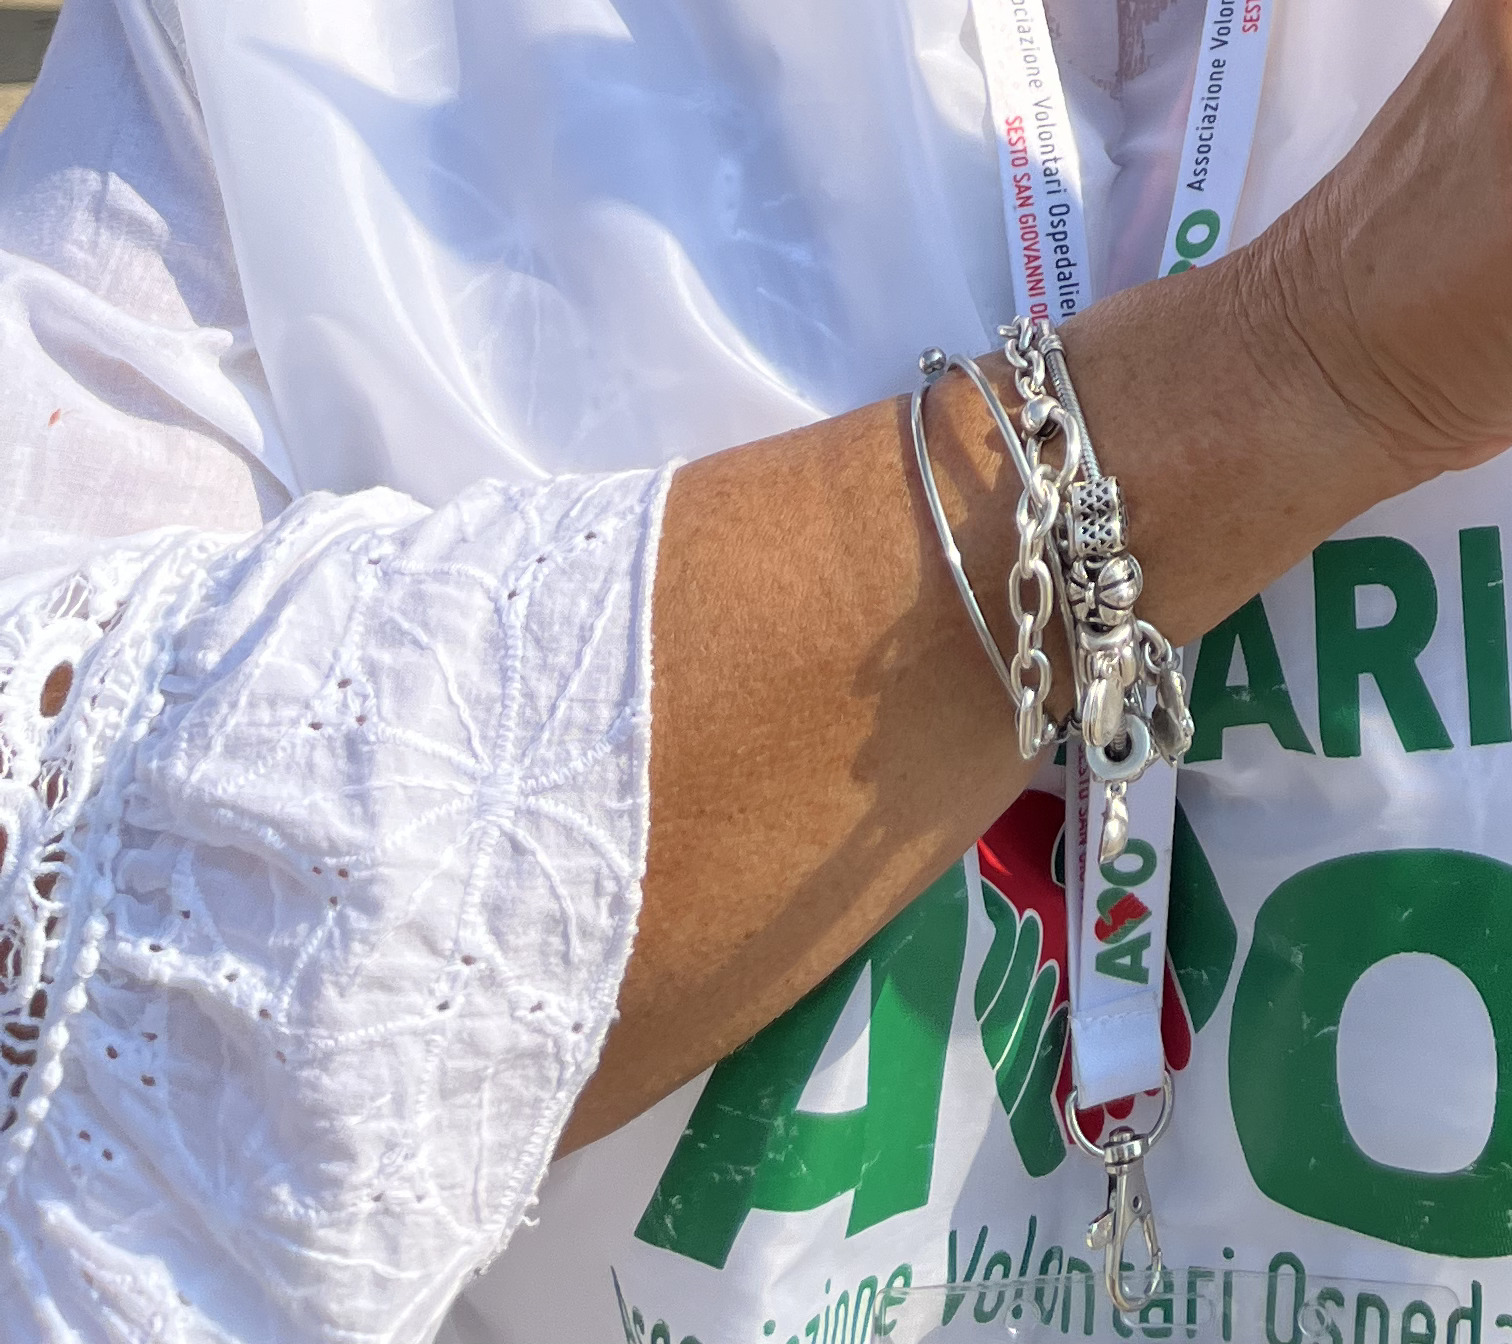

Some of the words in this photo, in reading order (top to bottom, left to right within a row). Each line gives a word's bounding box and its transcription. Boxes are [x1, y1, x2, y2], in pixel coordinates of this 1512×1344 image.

[1005, 116, 1029, 168] SESTO
[1033, 97, 1068, 195] Volontari
[1186, 58, 1227, 192] Associazione
[1013, 174, 1035, 209] SAN
[1018, 212, 1046, 297] GIOVANNI
[941, 1214, 1235, 1341] Volontari
